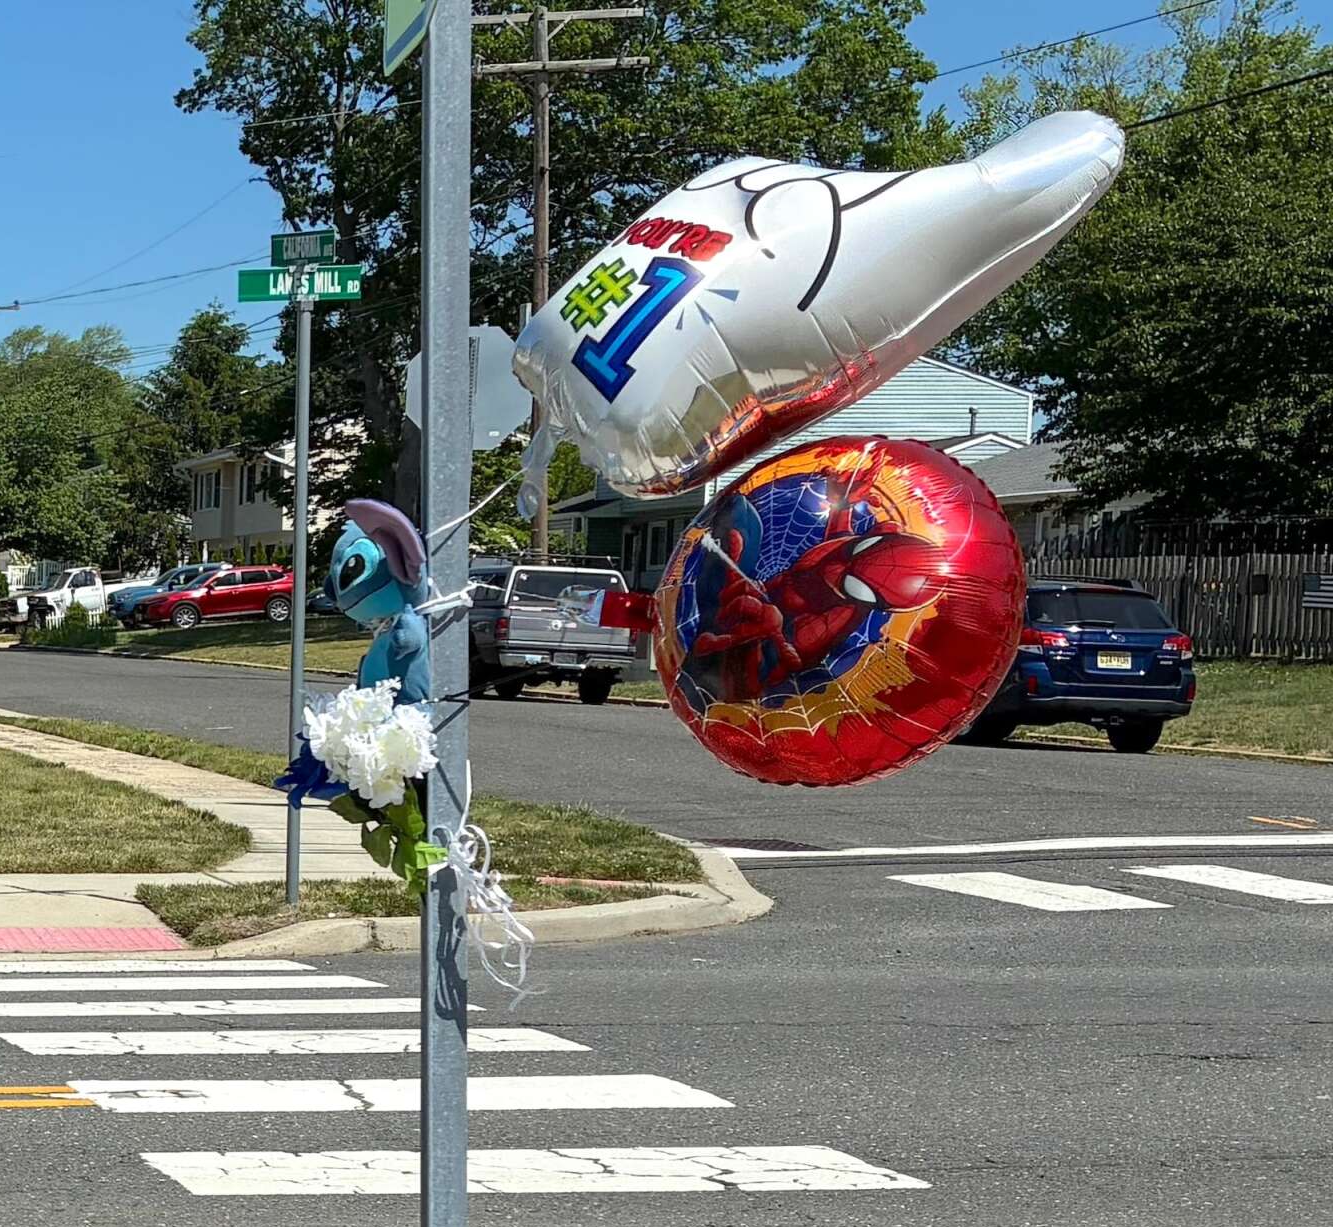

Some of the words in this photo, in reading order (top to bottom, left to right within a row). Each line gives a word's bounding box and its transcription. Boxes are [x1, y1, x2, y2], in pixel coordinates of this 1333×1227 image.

[611, 216, 733, 262] YOU'RE
[314, 271, 341, 293] MILL
[347, 280, 360, 294] RD
